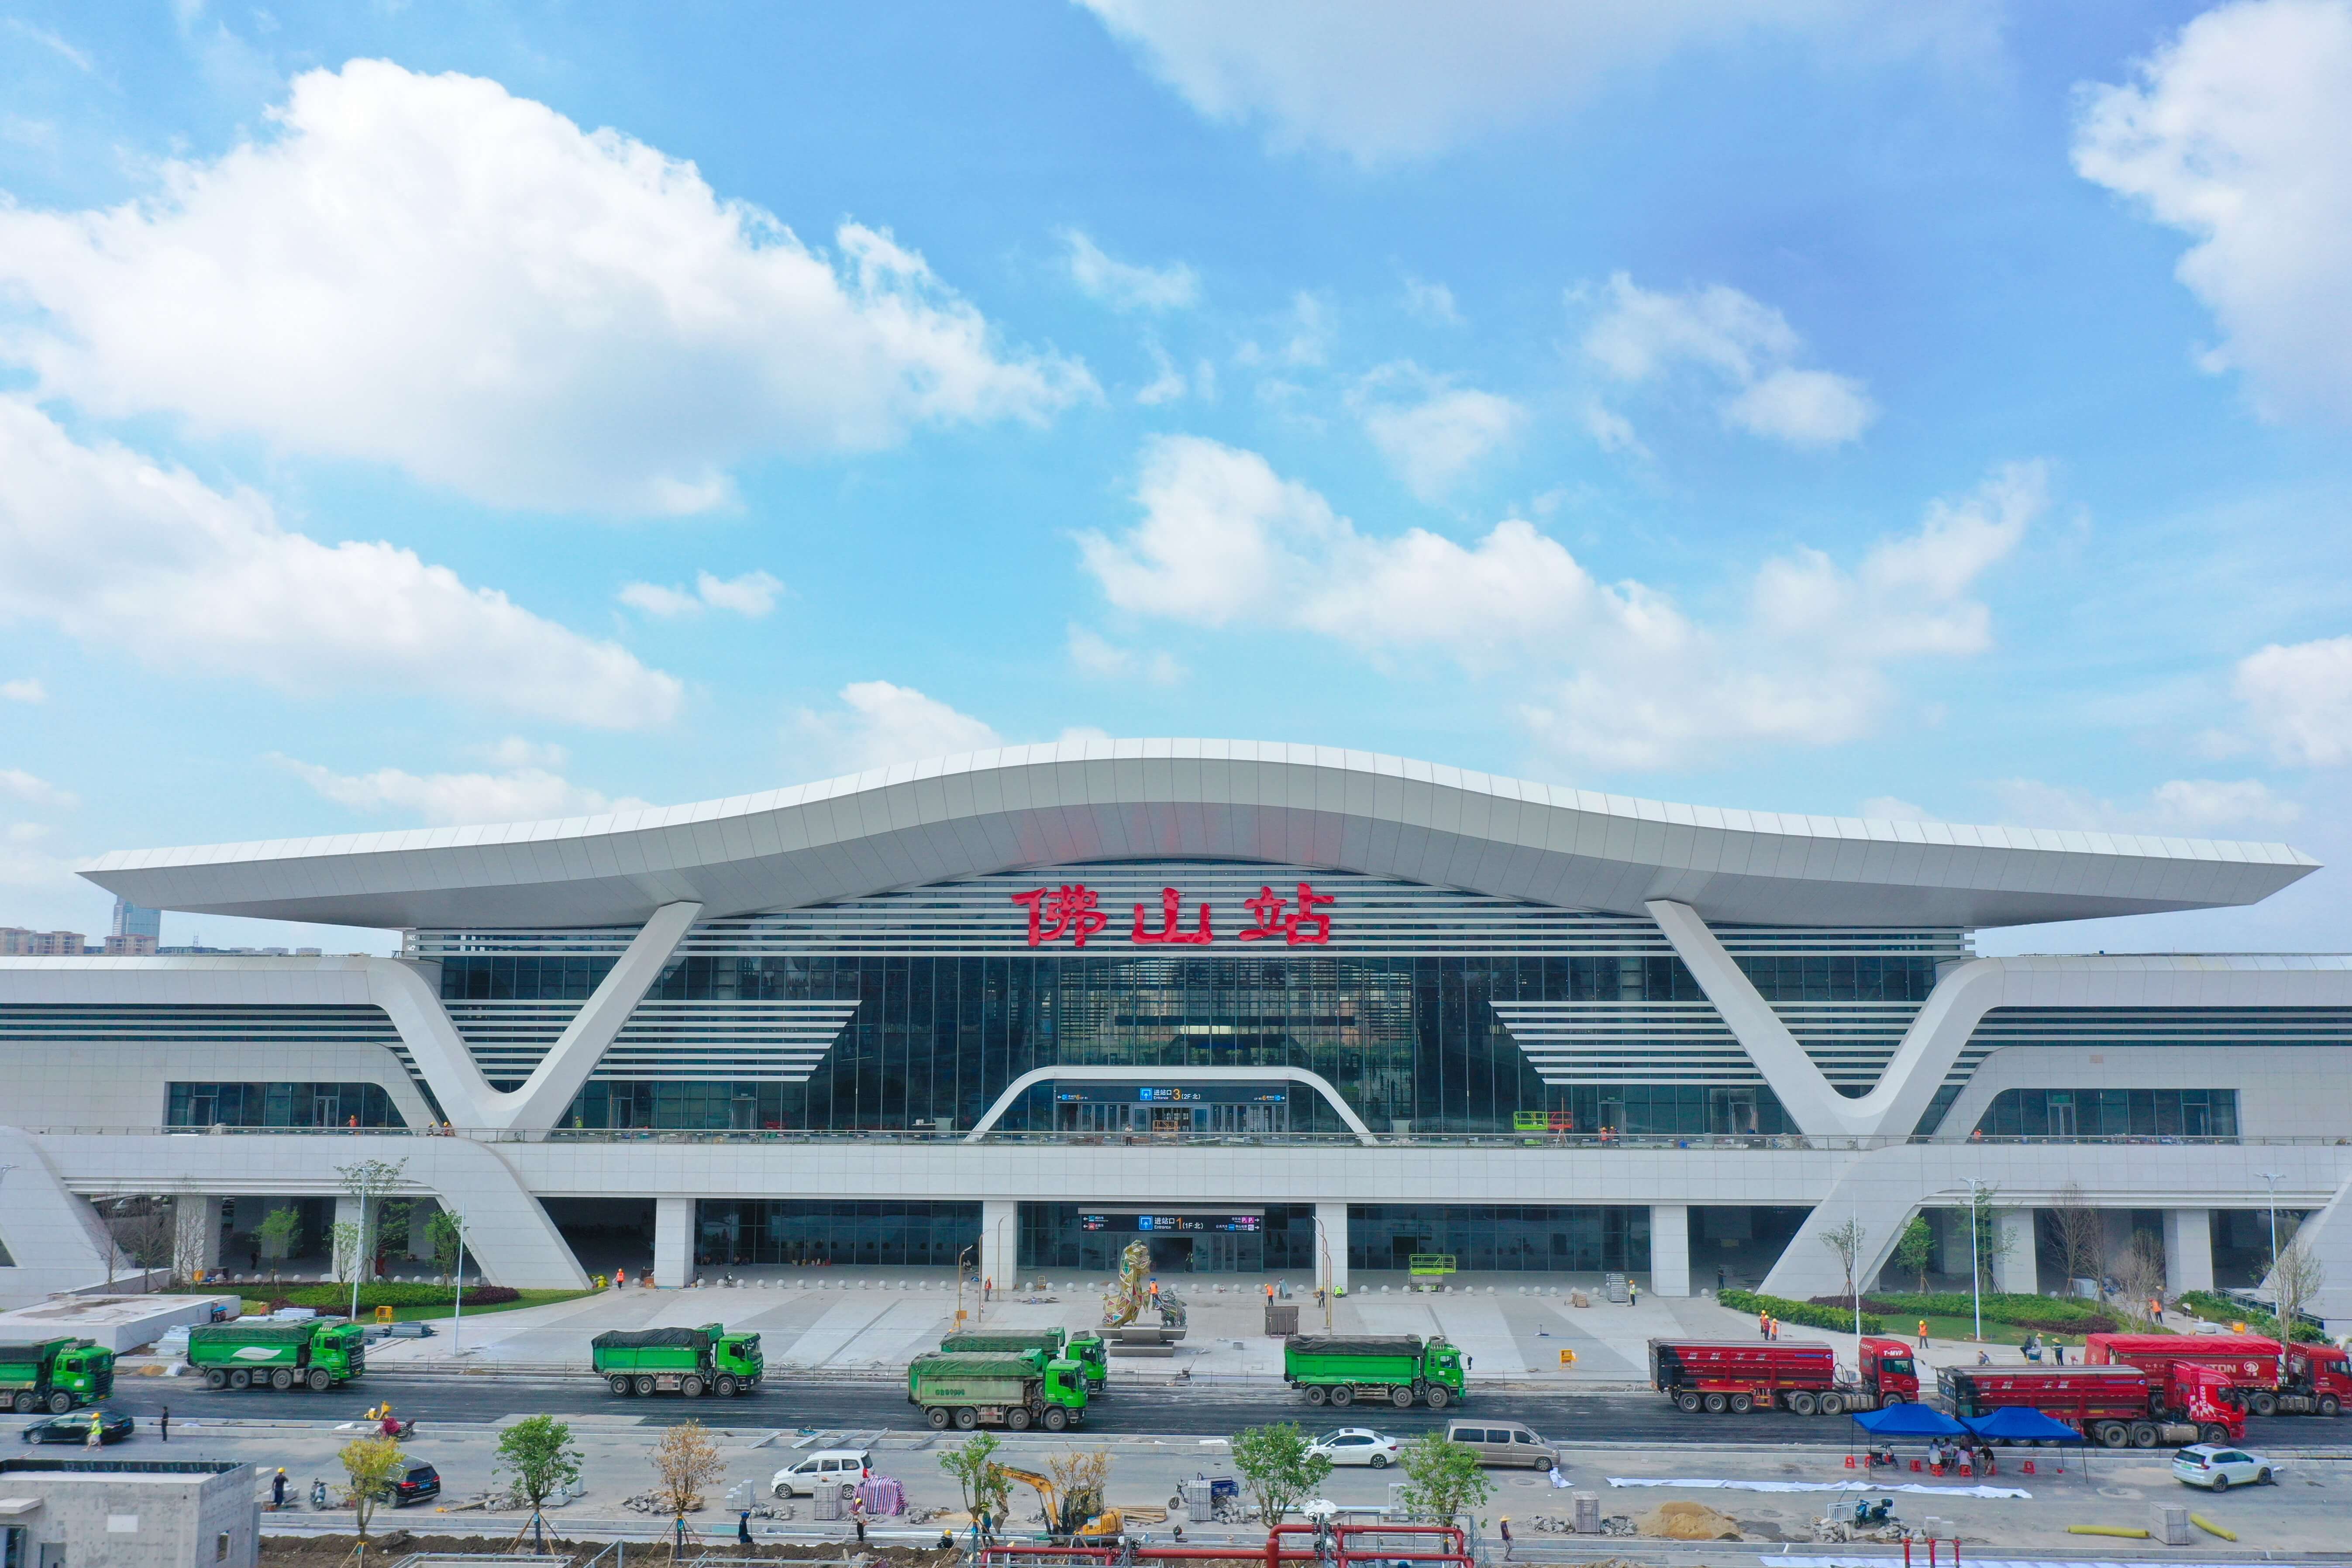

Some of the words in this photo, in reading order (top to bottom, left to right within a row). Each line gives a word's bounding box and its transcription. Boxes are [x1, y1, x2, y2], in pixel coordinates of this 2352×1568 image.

[1011, 882, 1334, 947] 佛山站
[1173, 1089, 1180, 1100] 3
[1176, 1217, 1181, 1229] 1
[2206, 1364, 2236, 1373] TON
